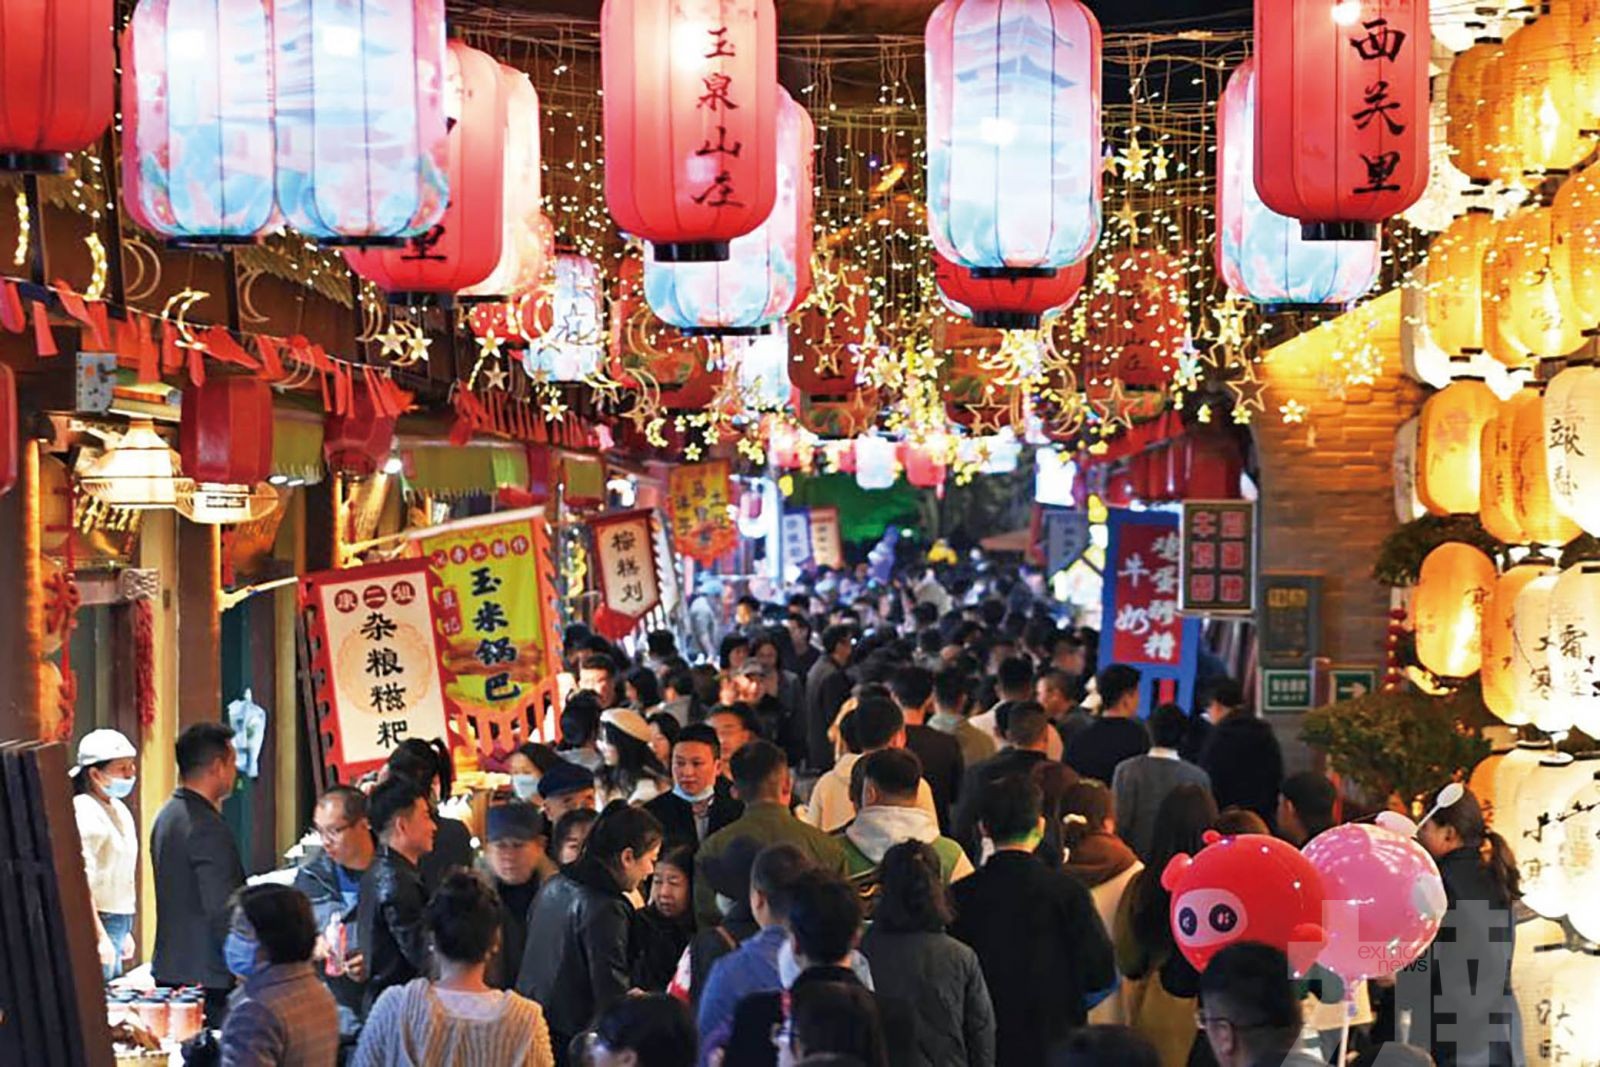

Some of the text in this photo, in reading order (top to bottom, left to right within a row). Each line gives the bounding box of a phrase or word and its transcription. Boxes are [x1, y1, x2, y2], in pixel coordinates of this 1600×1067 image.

[691, 26, 746, 208] 玉泉山庄
[1349, 18, 1407, 195] 西关里
[360, 611, 408, 749] 杂粮糍粑
[469, 566, 522, 701] 玉米锅巴
